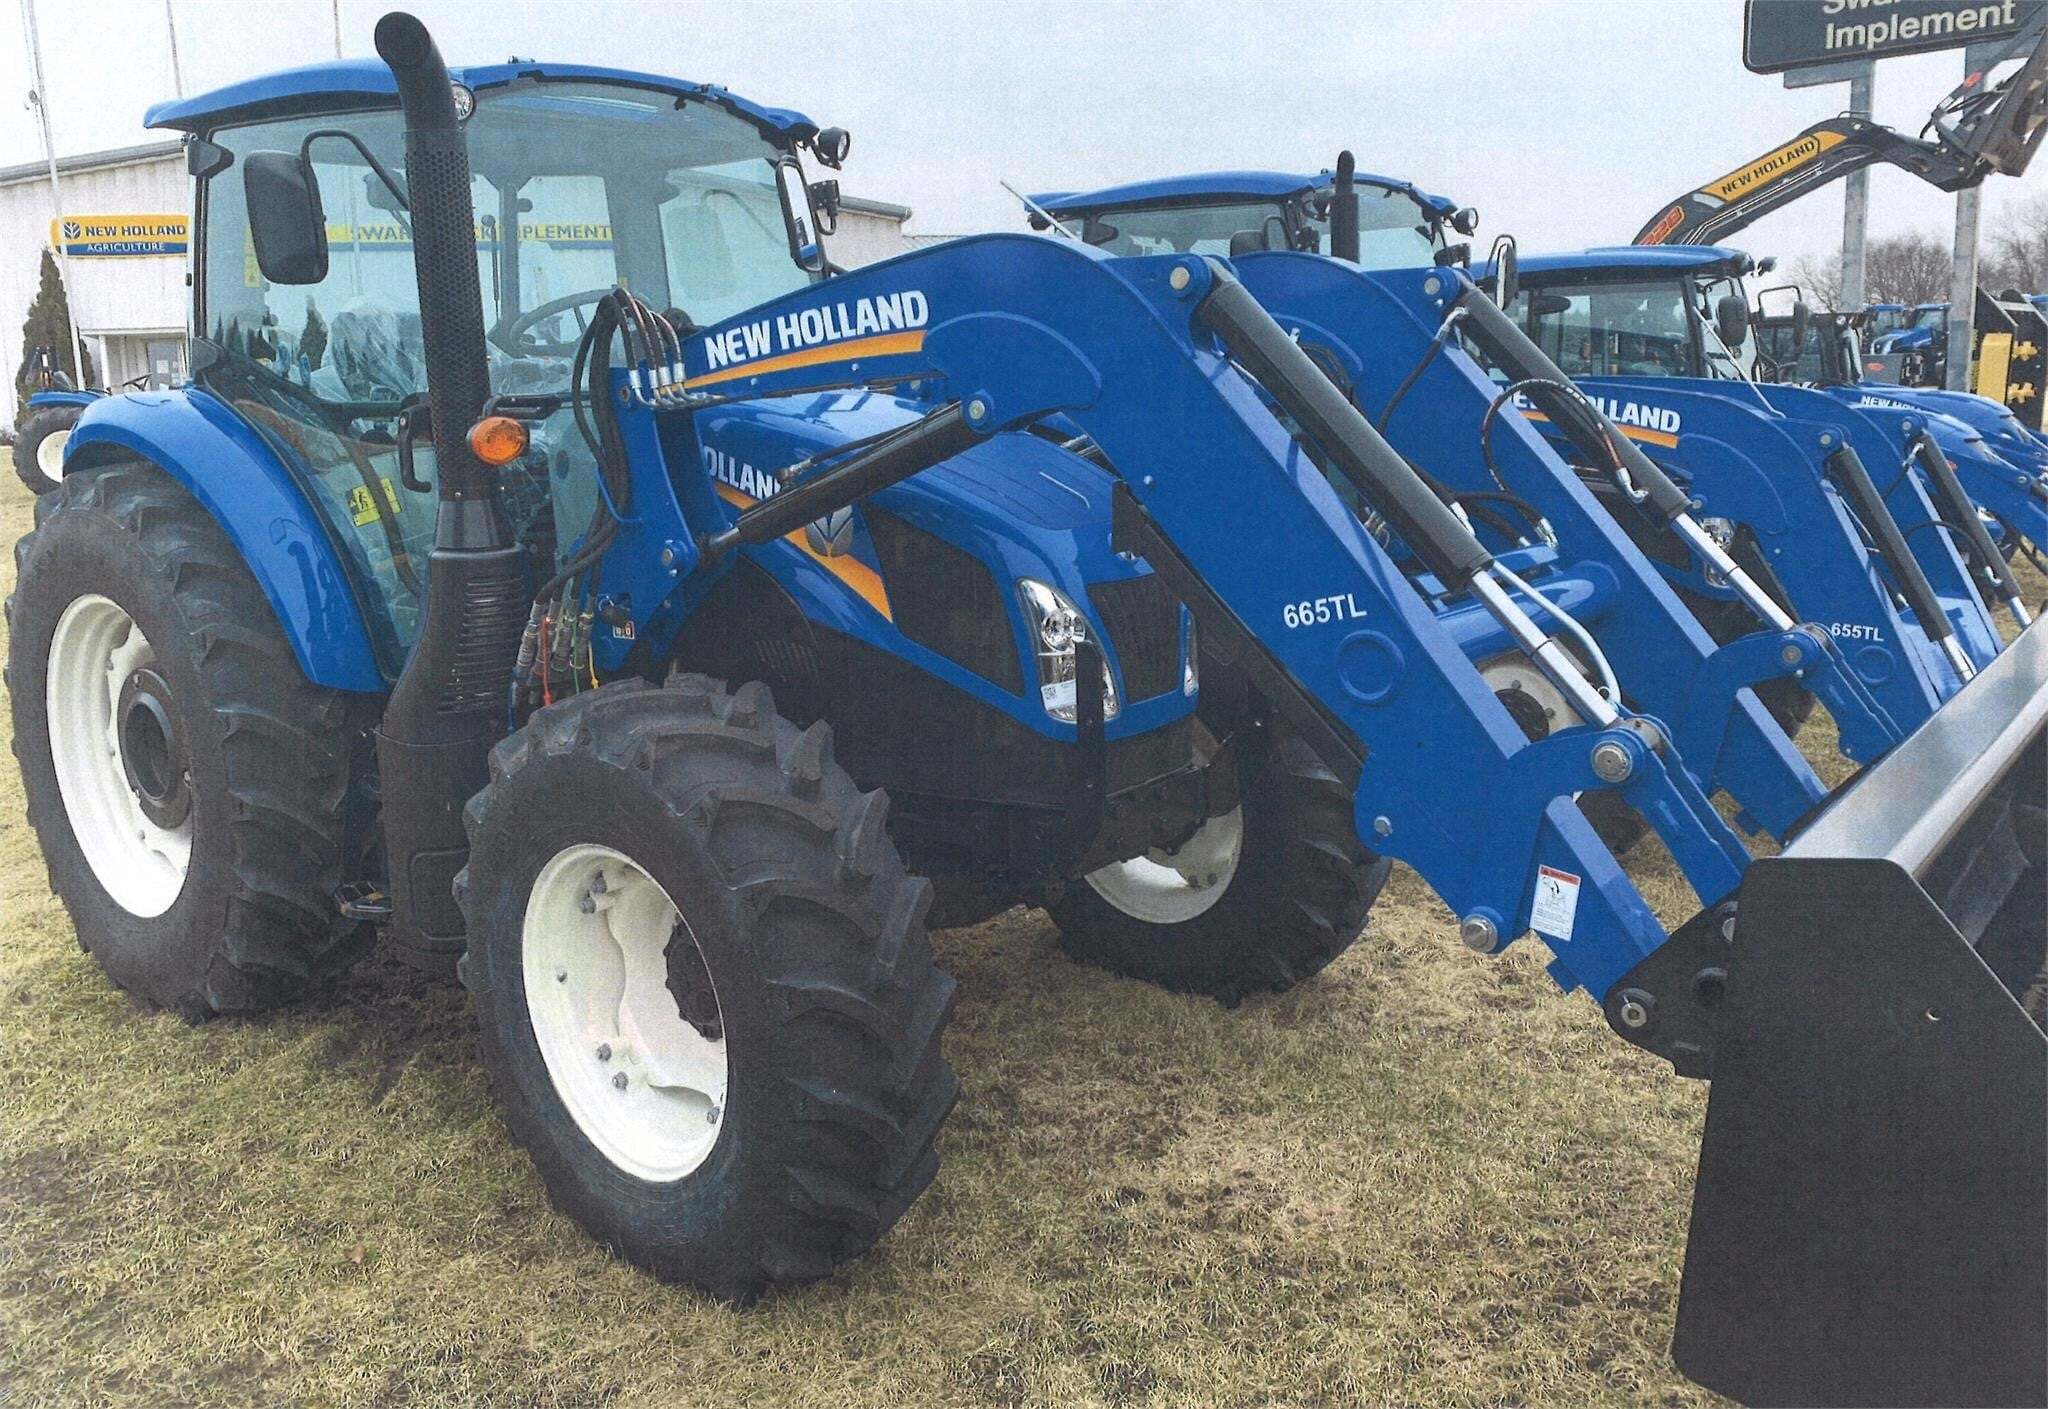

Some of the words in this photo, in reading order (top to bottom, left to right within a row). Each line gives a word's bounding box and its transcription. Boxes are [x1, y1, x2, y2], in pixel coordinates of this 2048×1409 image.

[1825, 1, 2016, 49] Implement
[1722, 172, 1751, 195] NEW
[1753, 140, 1815, 179] HOLLAND
[85, 226, 117, 236] NEW
[121, 225, 186, 236] HOLLAND
[86, 242, 165, 252] AGRICULTURE
[517, 224, 611, 239] PLEMENT
[704, 319, 771, 370] NEW
[776, 290, 929, 350] HOLLAND
[1587, 395, 1681, 433] LLAND
[1861, 395, 1891, 408] NEW
[703, 444, 781, 500] OLLAN
[1283, 593, 1368, 628] 665TL
[1831, 622, 1885, 642] 655TL
